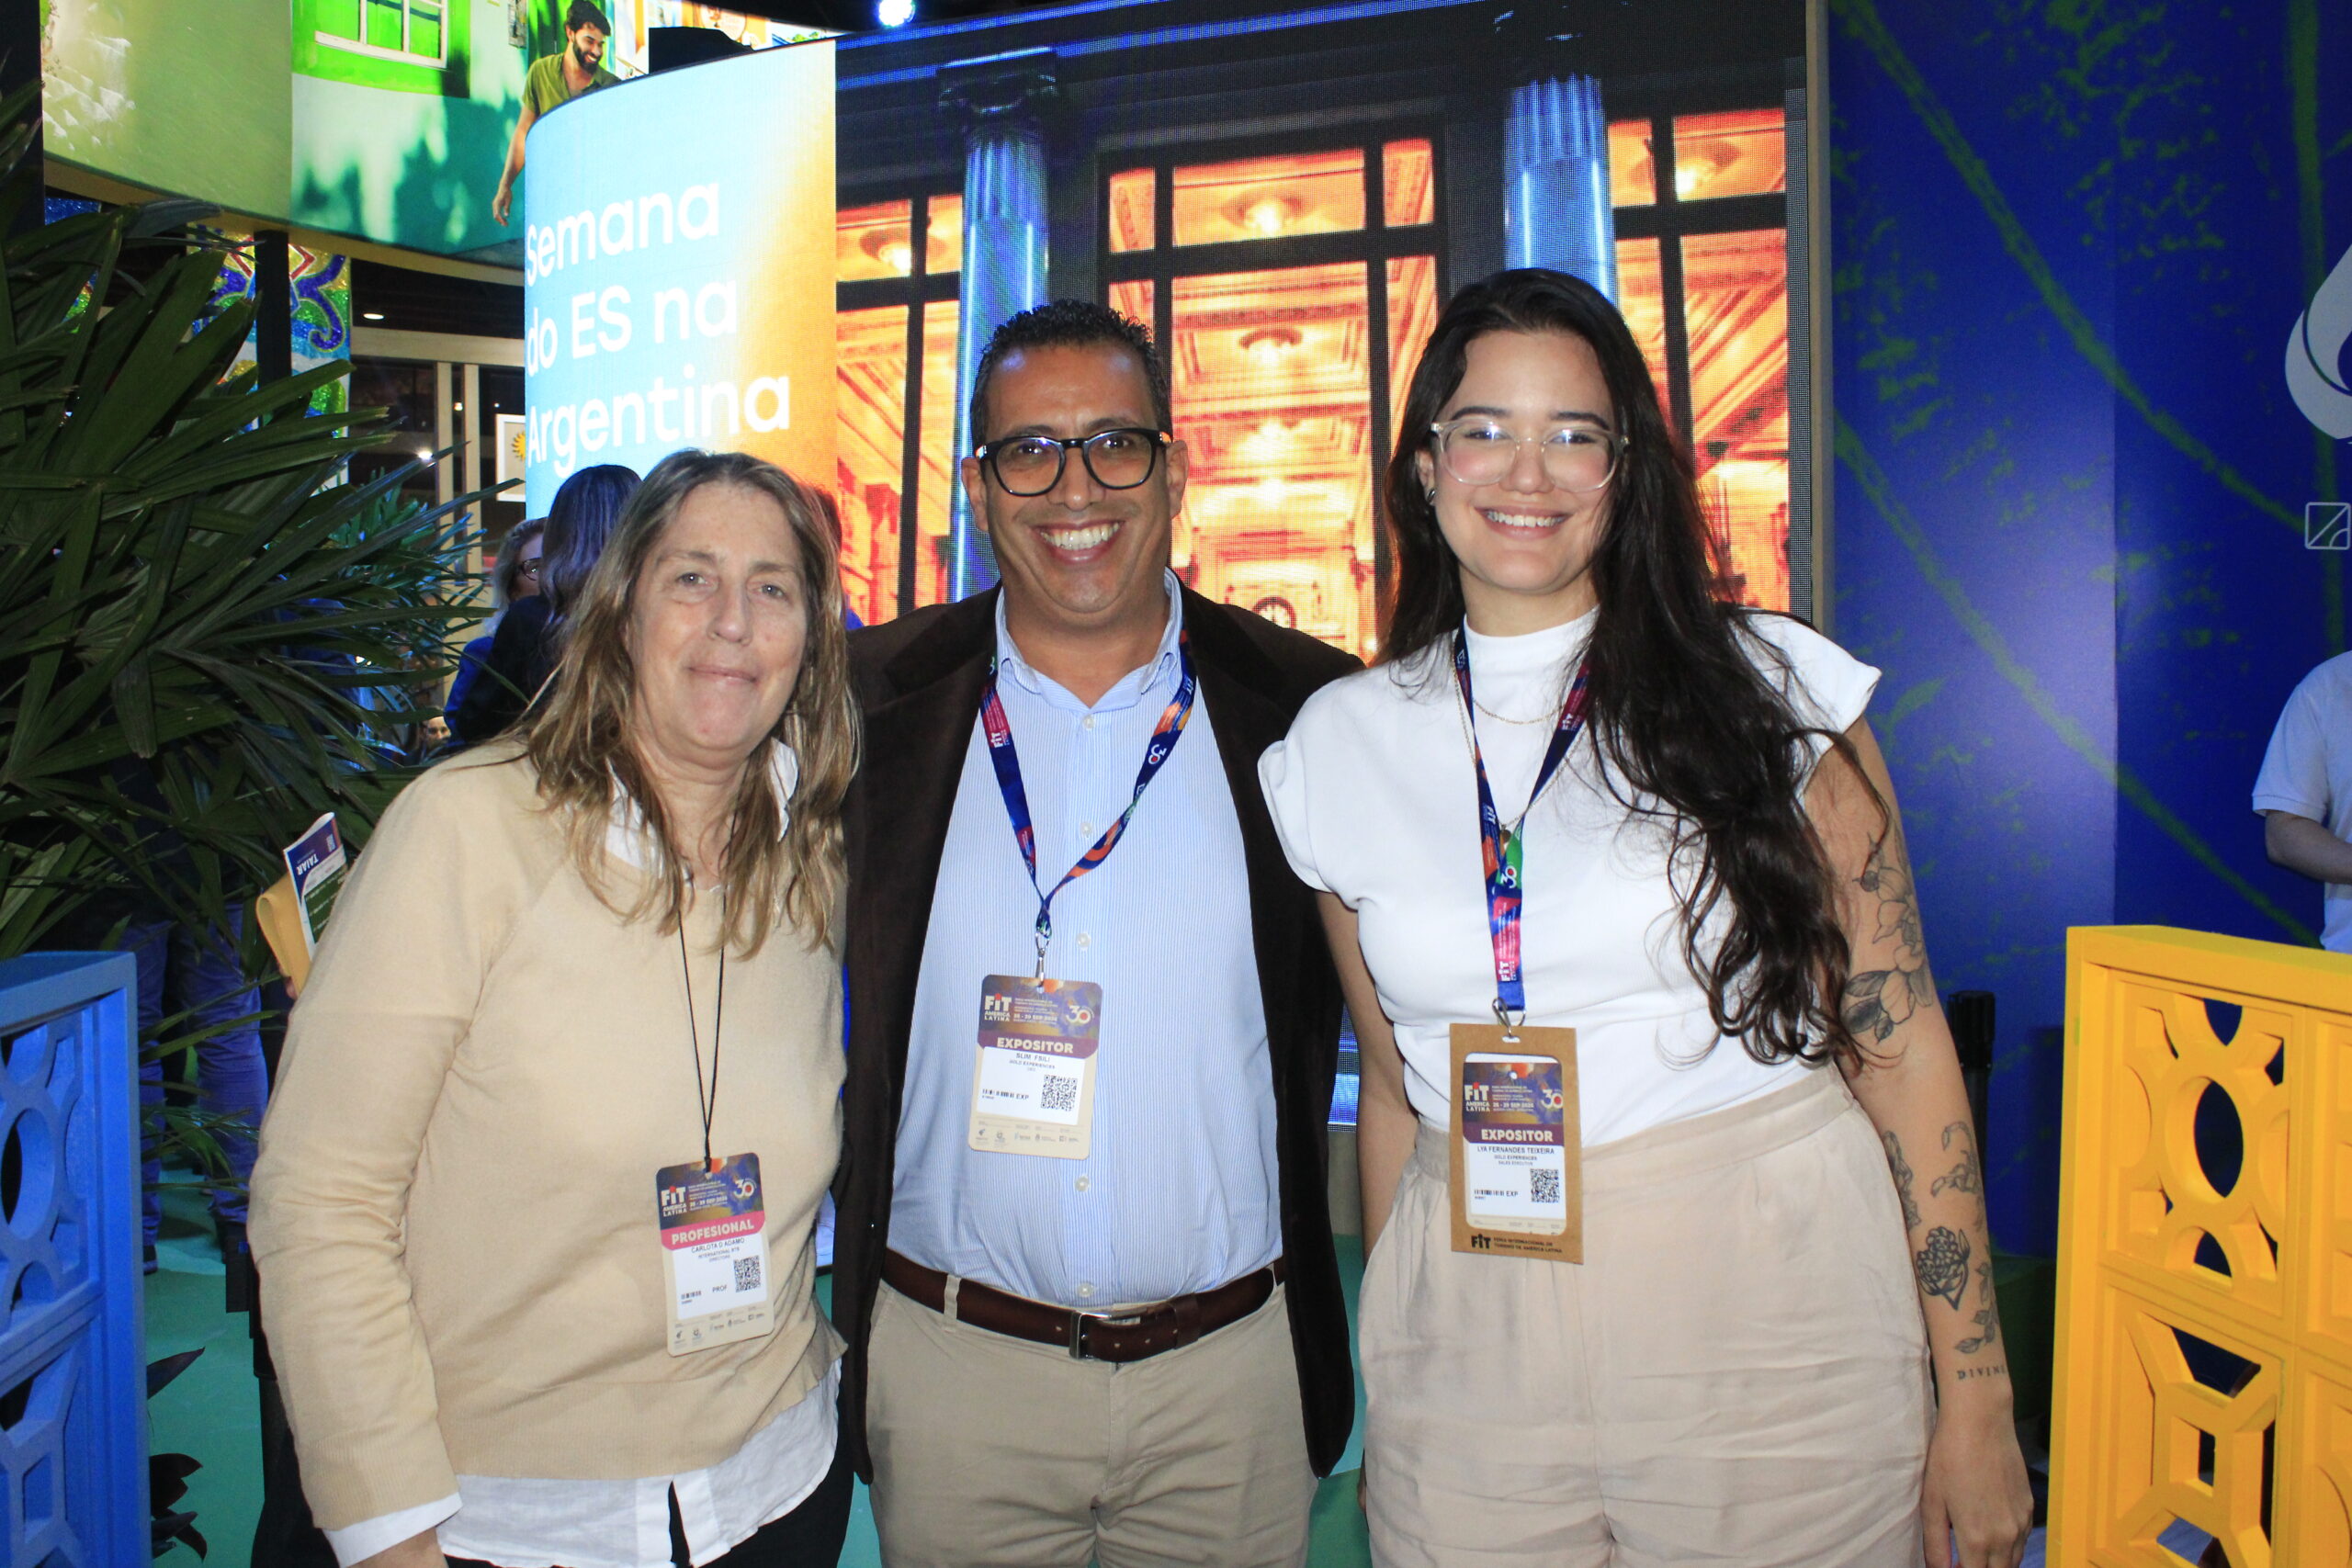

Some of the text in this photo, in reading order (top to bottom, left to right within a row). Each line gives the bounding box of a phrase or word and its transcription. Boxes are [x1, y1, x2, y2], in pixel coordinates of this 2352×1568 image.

[527, 184, 719, 286] Semana
[527, 280, 737, 378] do ES na
[527, 364, 790, 479] Argentina
[997, 1037, 1074, 1054] EXPOSITOR
[1481, 1128, 1554, 1143] EXPOSITOR
[672, 1219, 754, 1245] PROFESIONAL
[691, 1243, 718, 1254] CARLOTA
[724, 1237, 745, 1247] ADAMO
[712, 1284, 728, 1293] PROF
